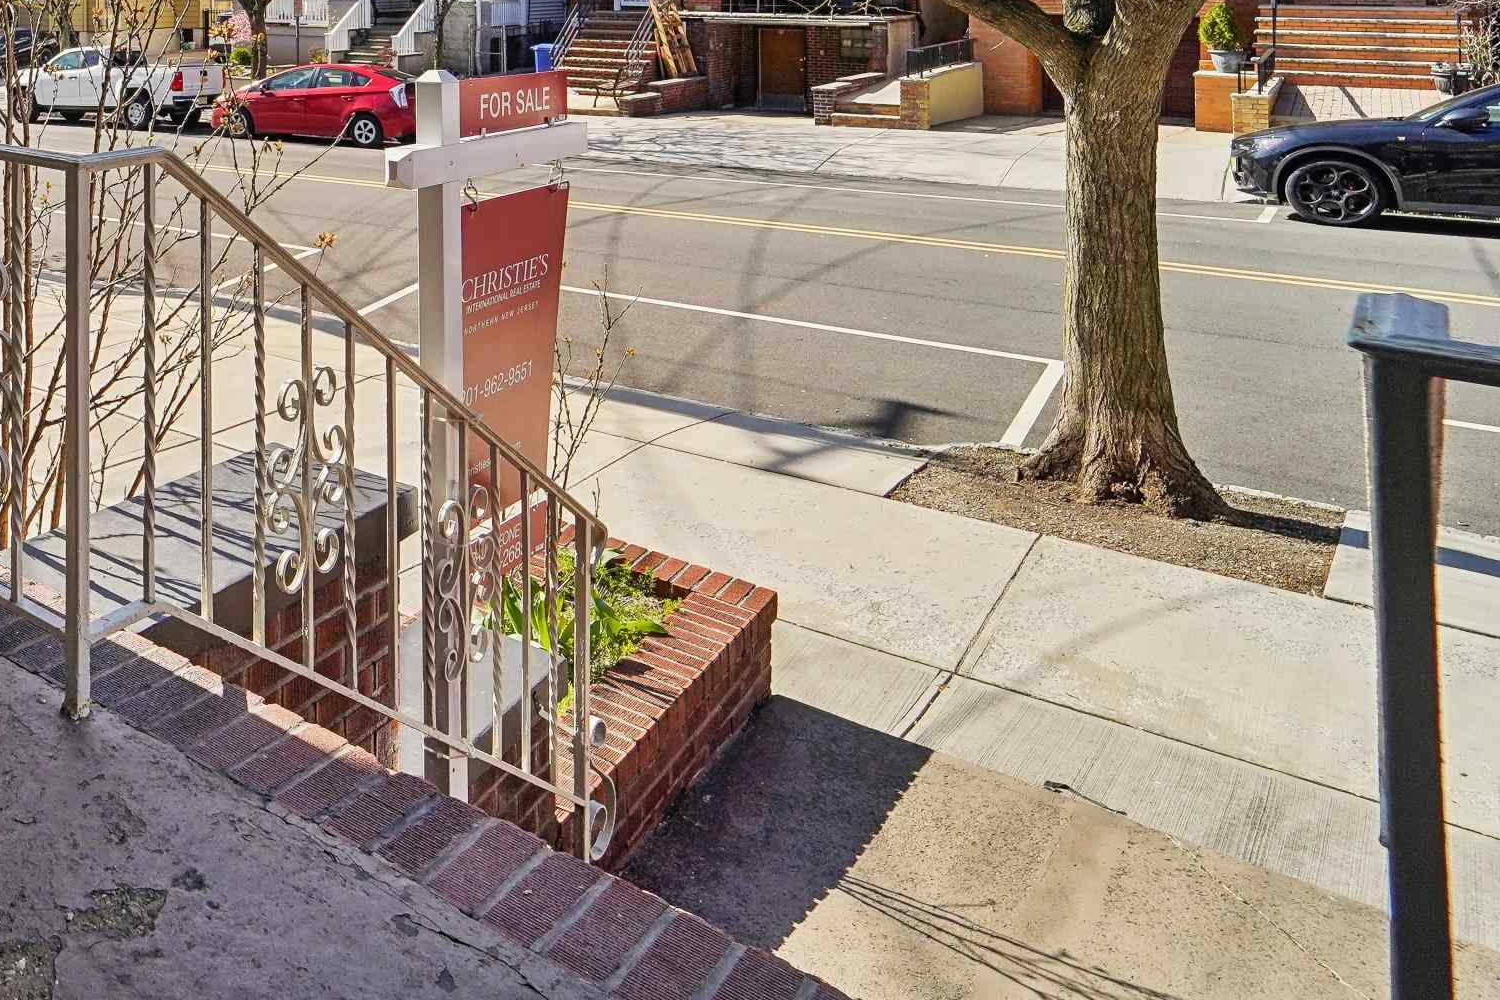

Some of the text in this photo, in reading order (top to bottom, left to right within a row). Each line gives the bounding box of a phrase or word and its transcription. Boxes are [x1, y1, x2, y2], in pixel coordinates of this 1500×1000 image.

[480, 86, 550, 120] FOR SALE
[461, 253, 549, 303] CHRISTIE'S
